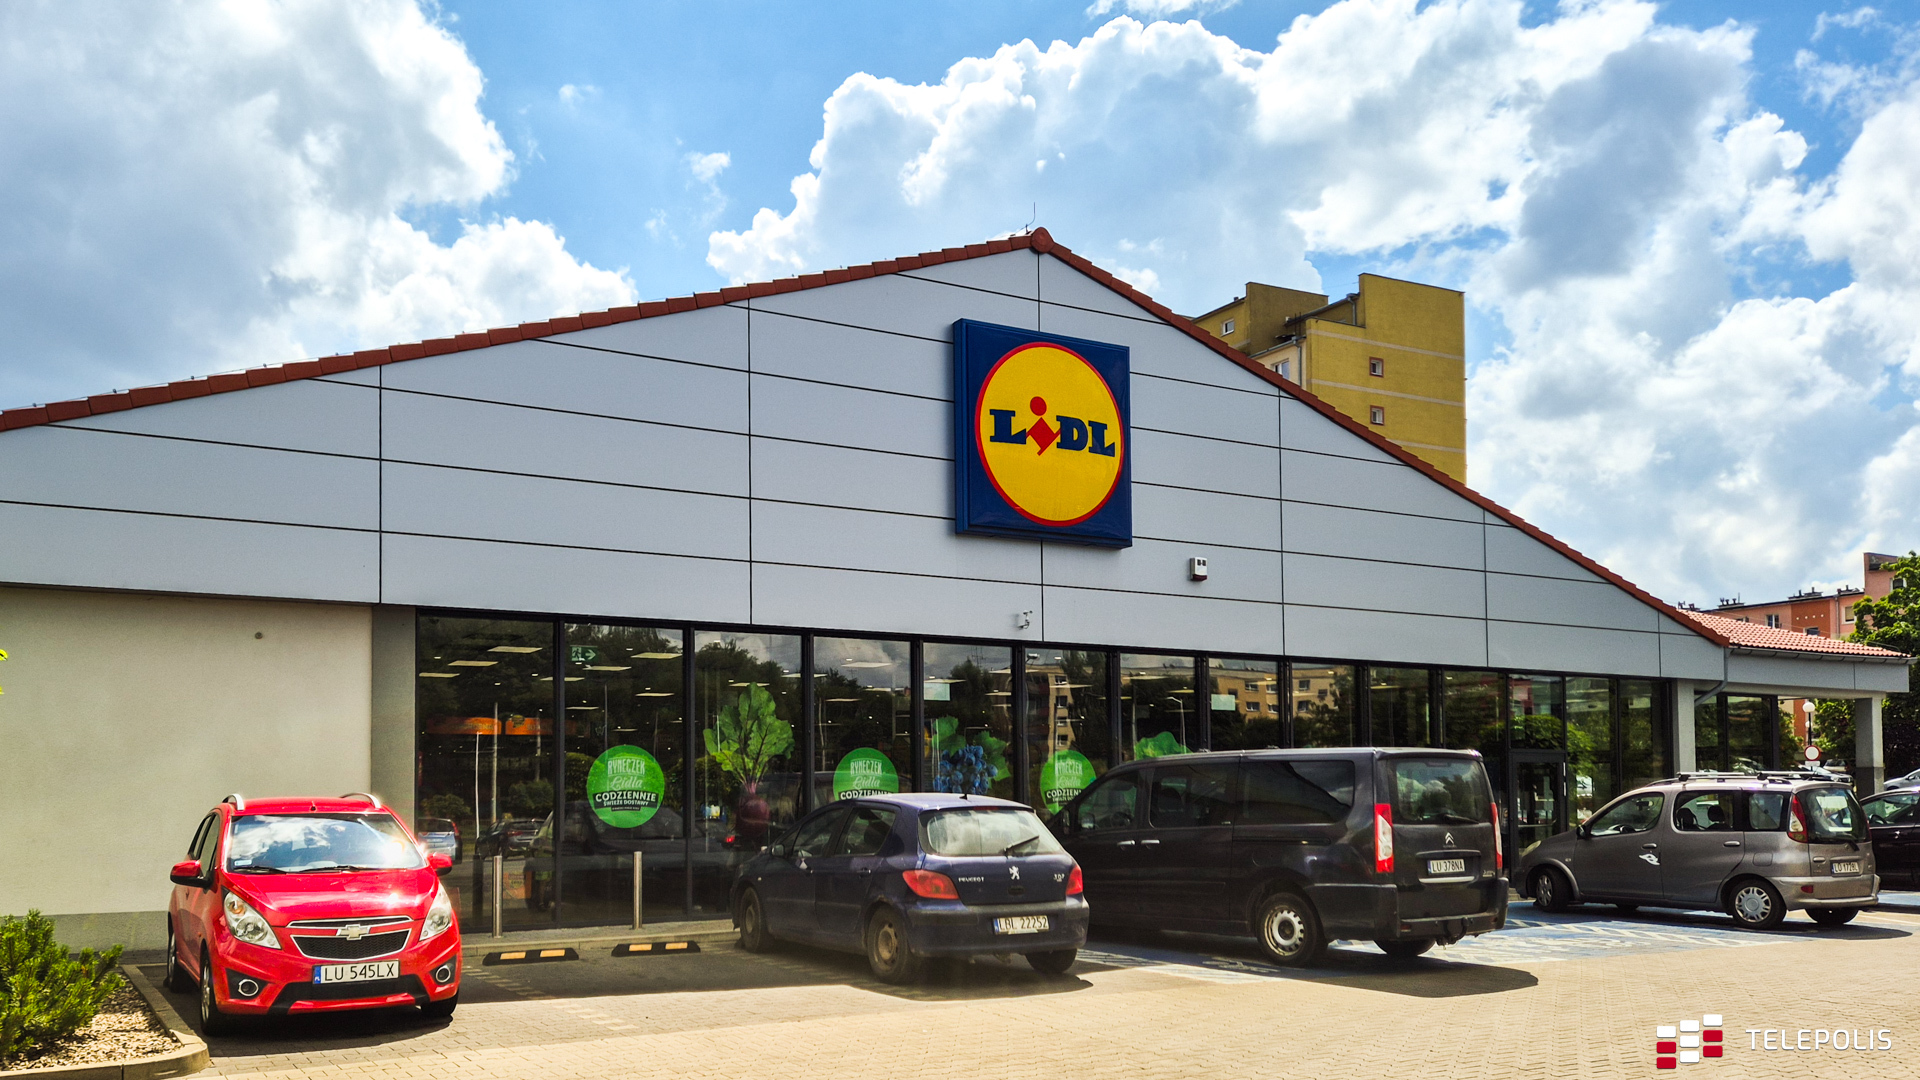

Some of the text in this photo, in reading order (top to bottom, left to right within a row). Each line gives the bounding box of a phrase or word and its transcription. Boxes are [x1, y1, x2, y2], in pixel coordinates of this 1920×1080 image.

[607, 758, 645, 775] RYNECZEK
[850, 759, 883, 775] RYNECZEK
[610, 775, 643, 790] Lidla
[852, 775, 881, 790] Lidla
[595, 791, 657, 802] CODZIENNIE
[1046, 788, 1082, 798] CODZIEN
[1432, 860, 1464, 872] LU 378NA
[998, 916, 1048, 931] LBL 22252
[325, 963, 394, 981] LU 545LX
